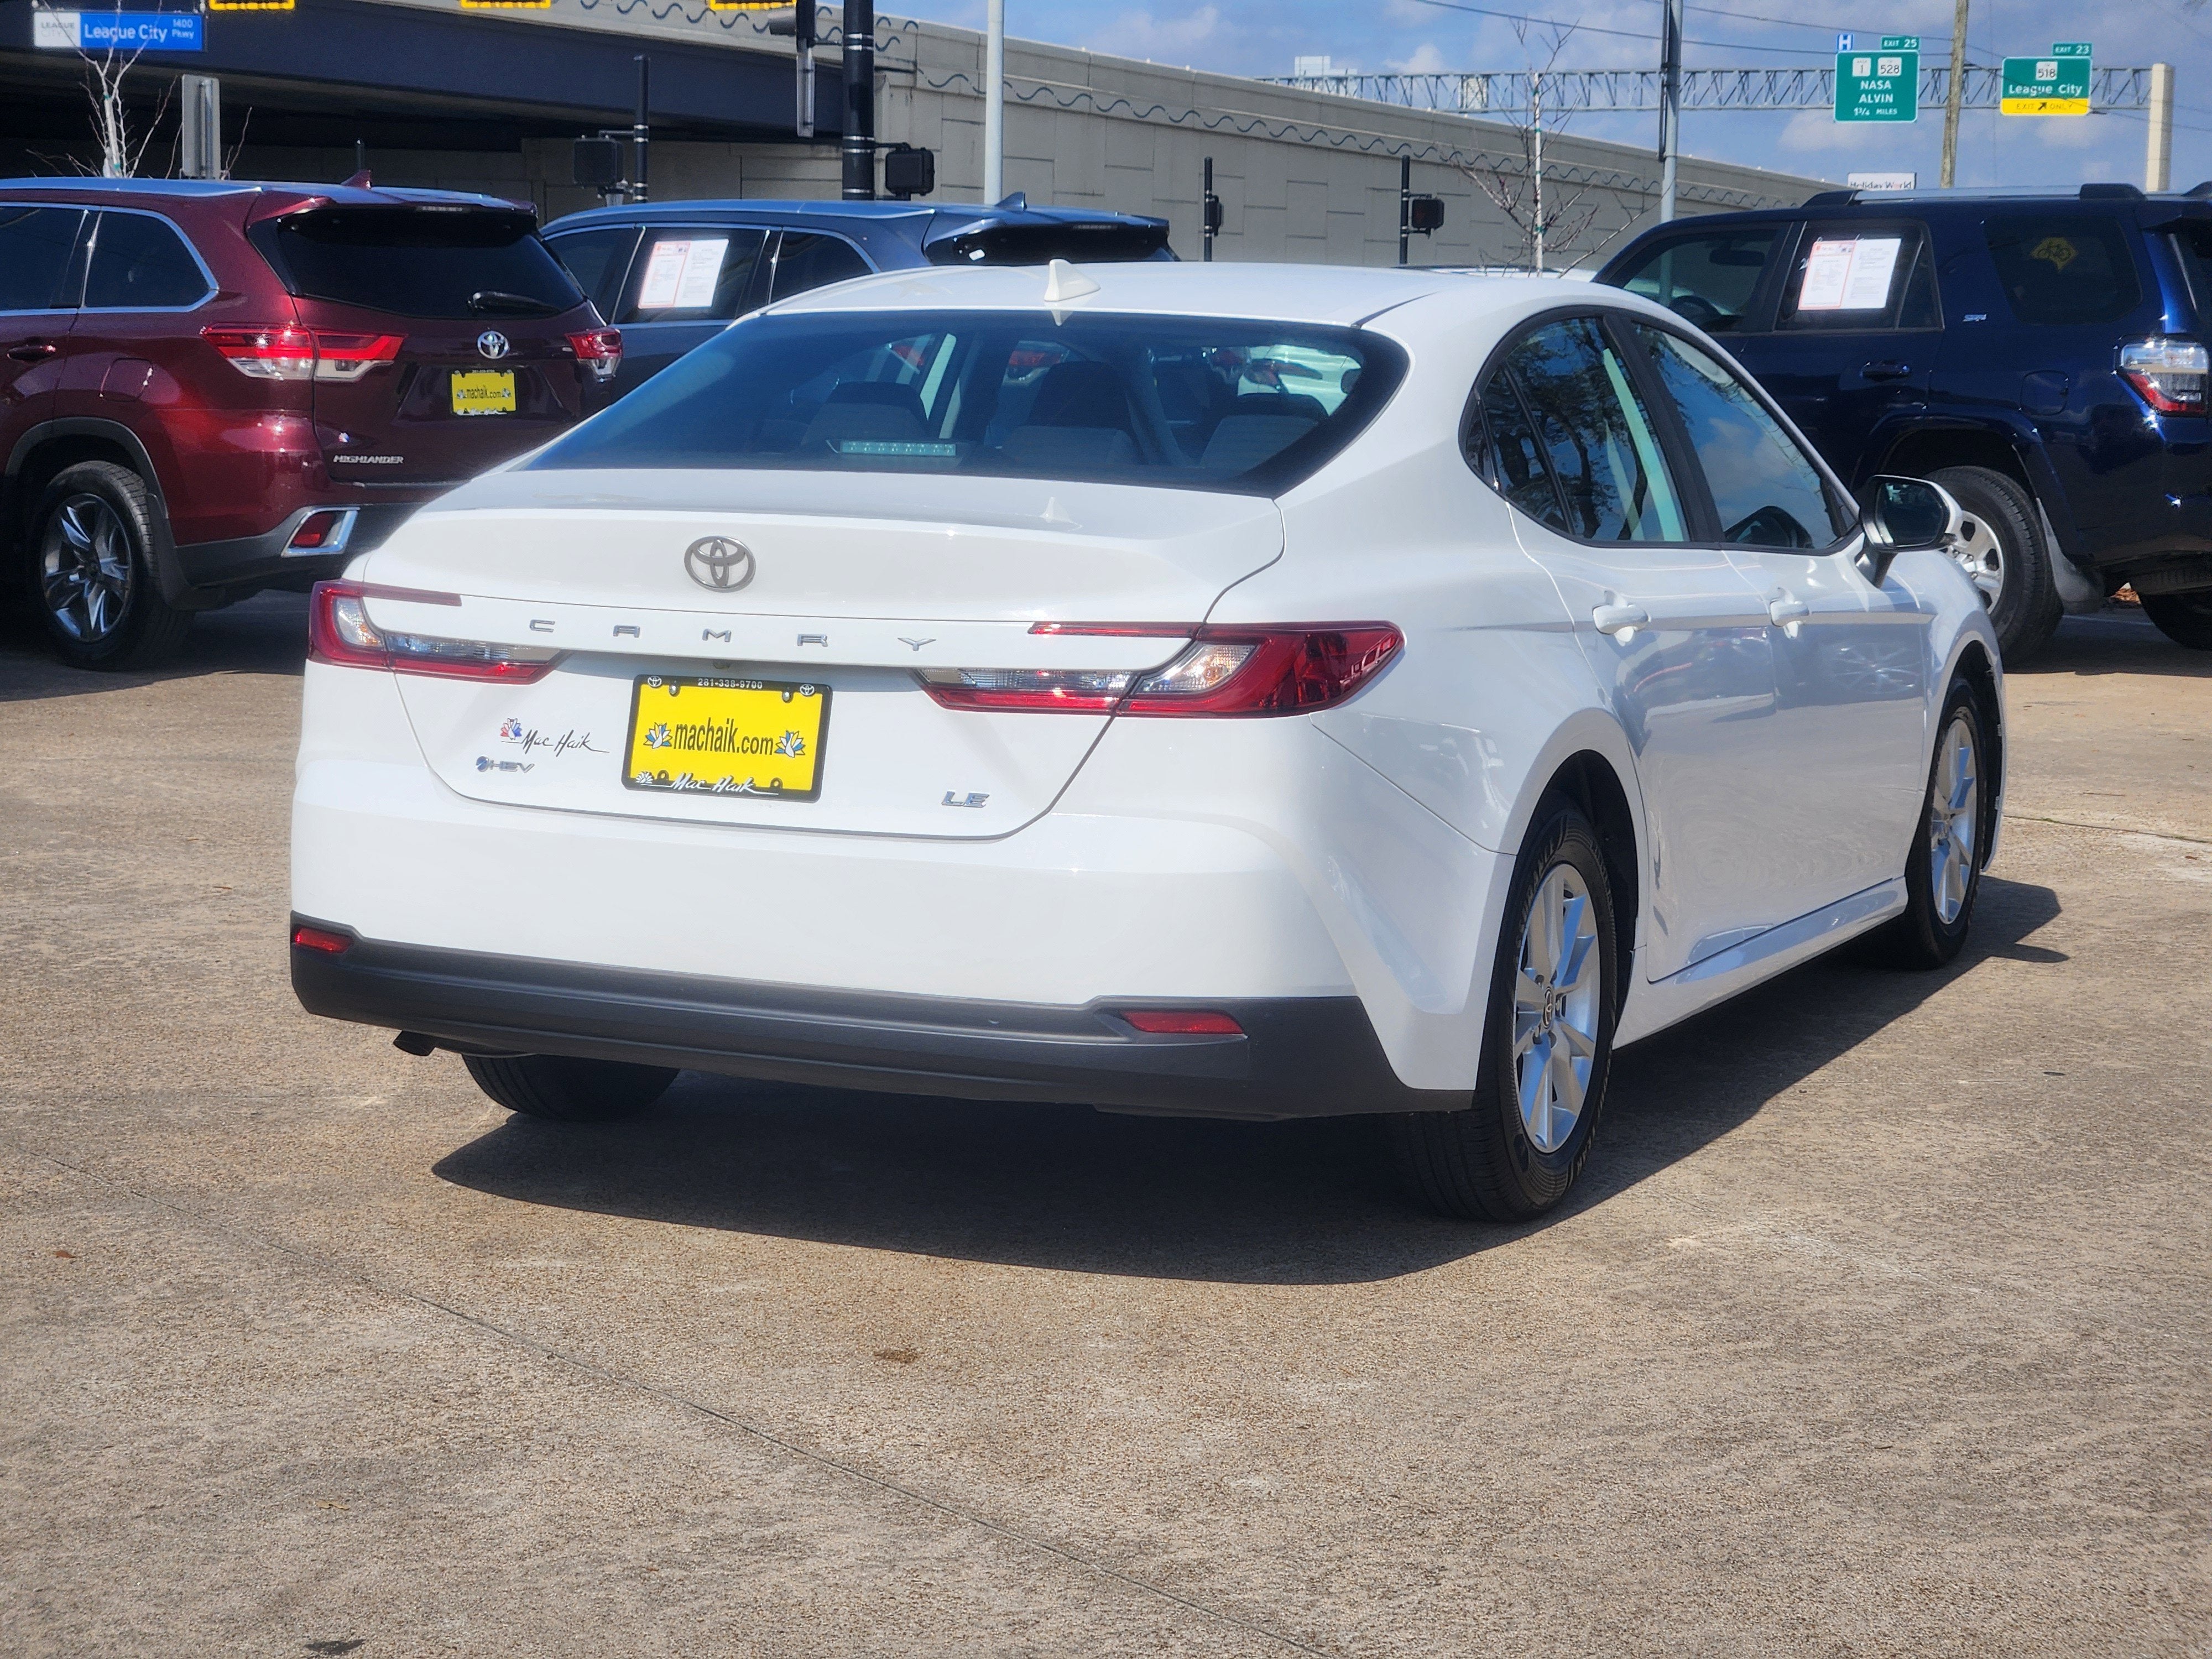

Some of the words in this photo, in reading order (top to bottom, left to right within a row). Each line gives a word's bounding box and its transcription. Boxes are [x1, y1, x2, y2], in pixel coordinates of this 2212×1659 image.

[173, 19, 194, 28] 1400
[85, 23, 136, 43] League
[139, 24, 168, 43] City
[171, 29, 194, 40] Pkwy
[1904, 38, 1917, 48] 25
[2076, 45, 2089, 54] 23
[1860, 64, 1864, 74] 1
[1880, 64, 1900, 75] 528
[2037, 68, 2056, 79] 518
[1860, 80, 1892, 90] NASA
[2008, 84, 2053, 97] League
[2058, 84, 2083, 96] City
[1859, 93, 1893, 103] ALVIN
[333, 455, 404, 464] HIGHLANDER
[529, 618, 937, 652] CAMRY
[697, 678, 763, 690] 281-338-9700
[672, 717, 774, 756] machaik.com
[519, 729, 554, 755] Mac
[554, 729, 602, 758] Haik
[488, 759, 535, 774] HEV
[670, 772, 712, 790] Mac
[712, 775, 768, 795] Haik
[941, 791, 990, 808] LE
